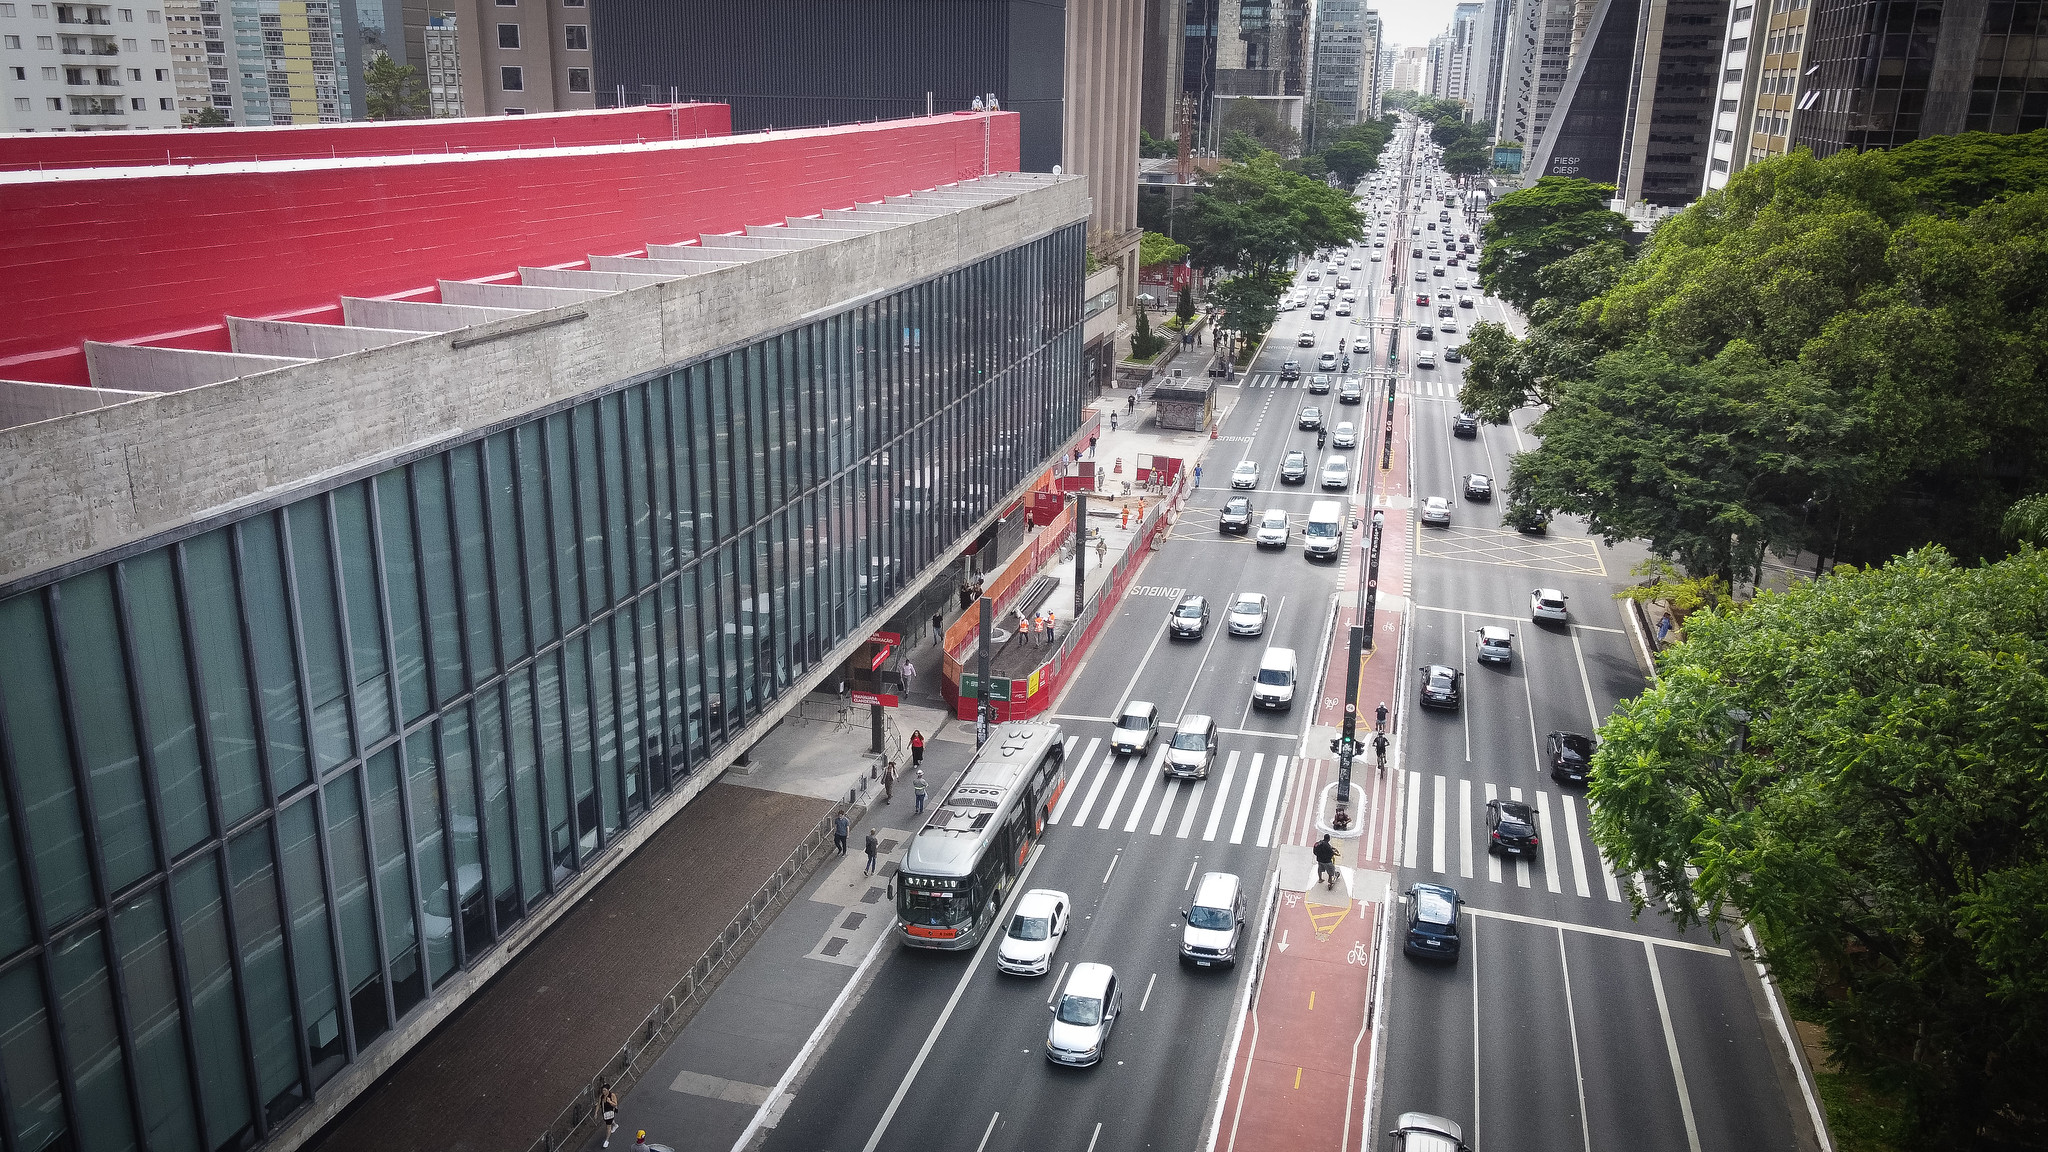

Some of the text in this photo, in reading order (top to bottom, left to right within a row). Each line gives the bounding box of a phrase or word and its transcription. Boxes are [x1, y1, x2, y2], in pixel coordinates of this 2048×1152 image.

[1554, 157, 1580, 165] FIESP
[1552, 166, 1579, 174] CIESP
[1131, 585, 1180, 600] ÔNIBUS
